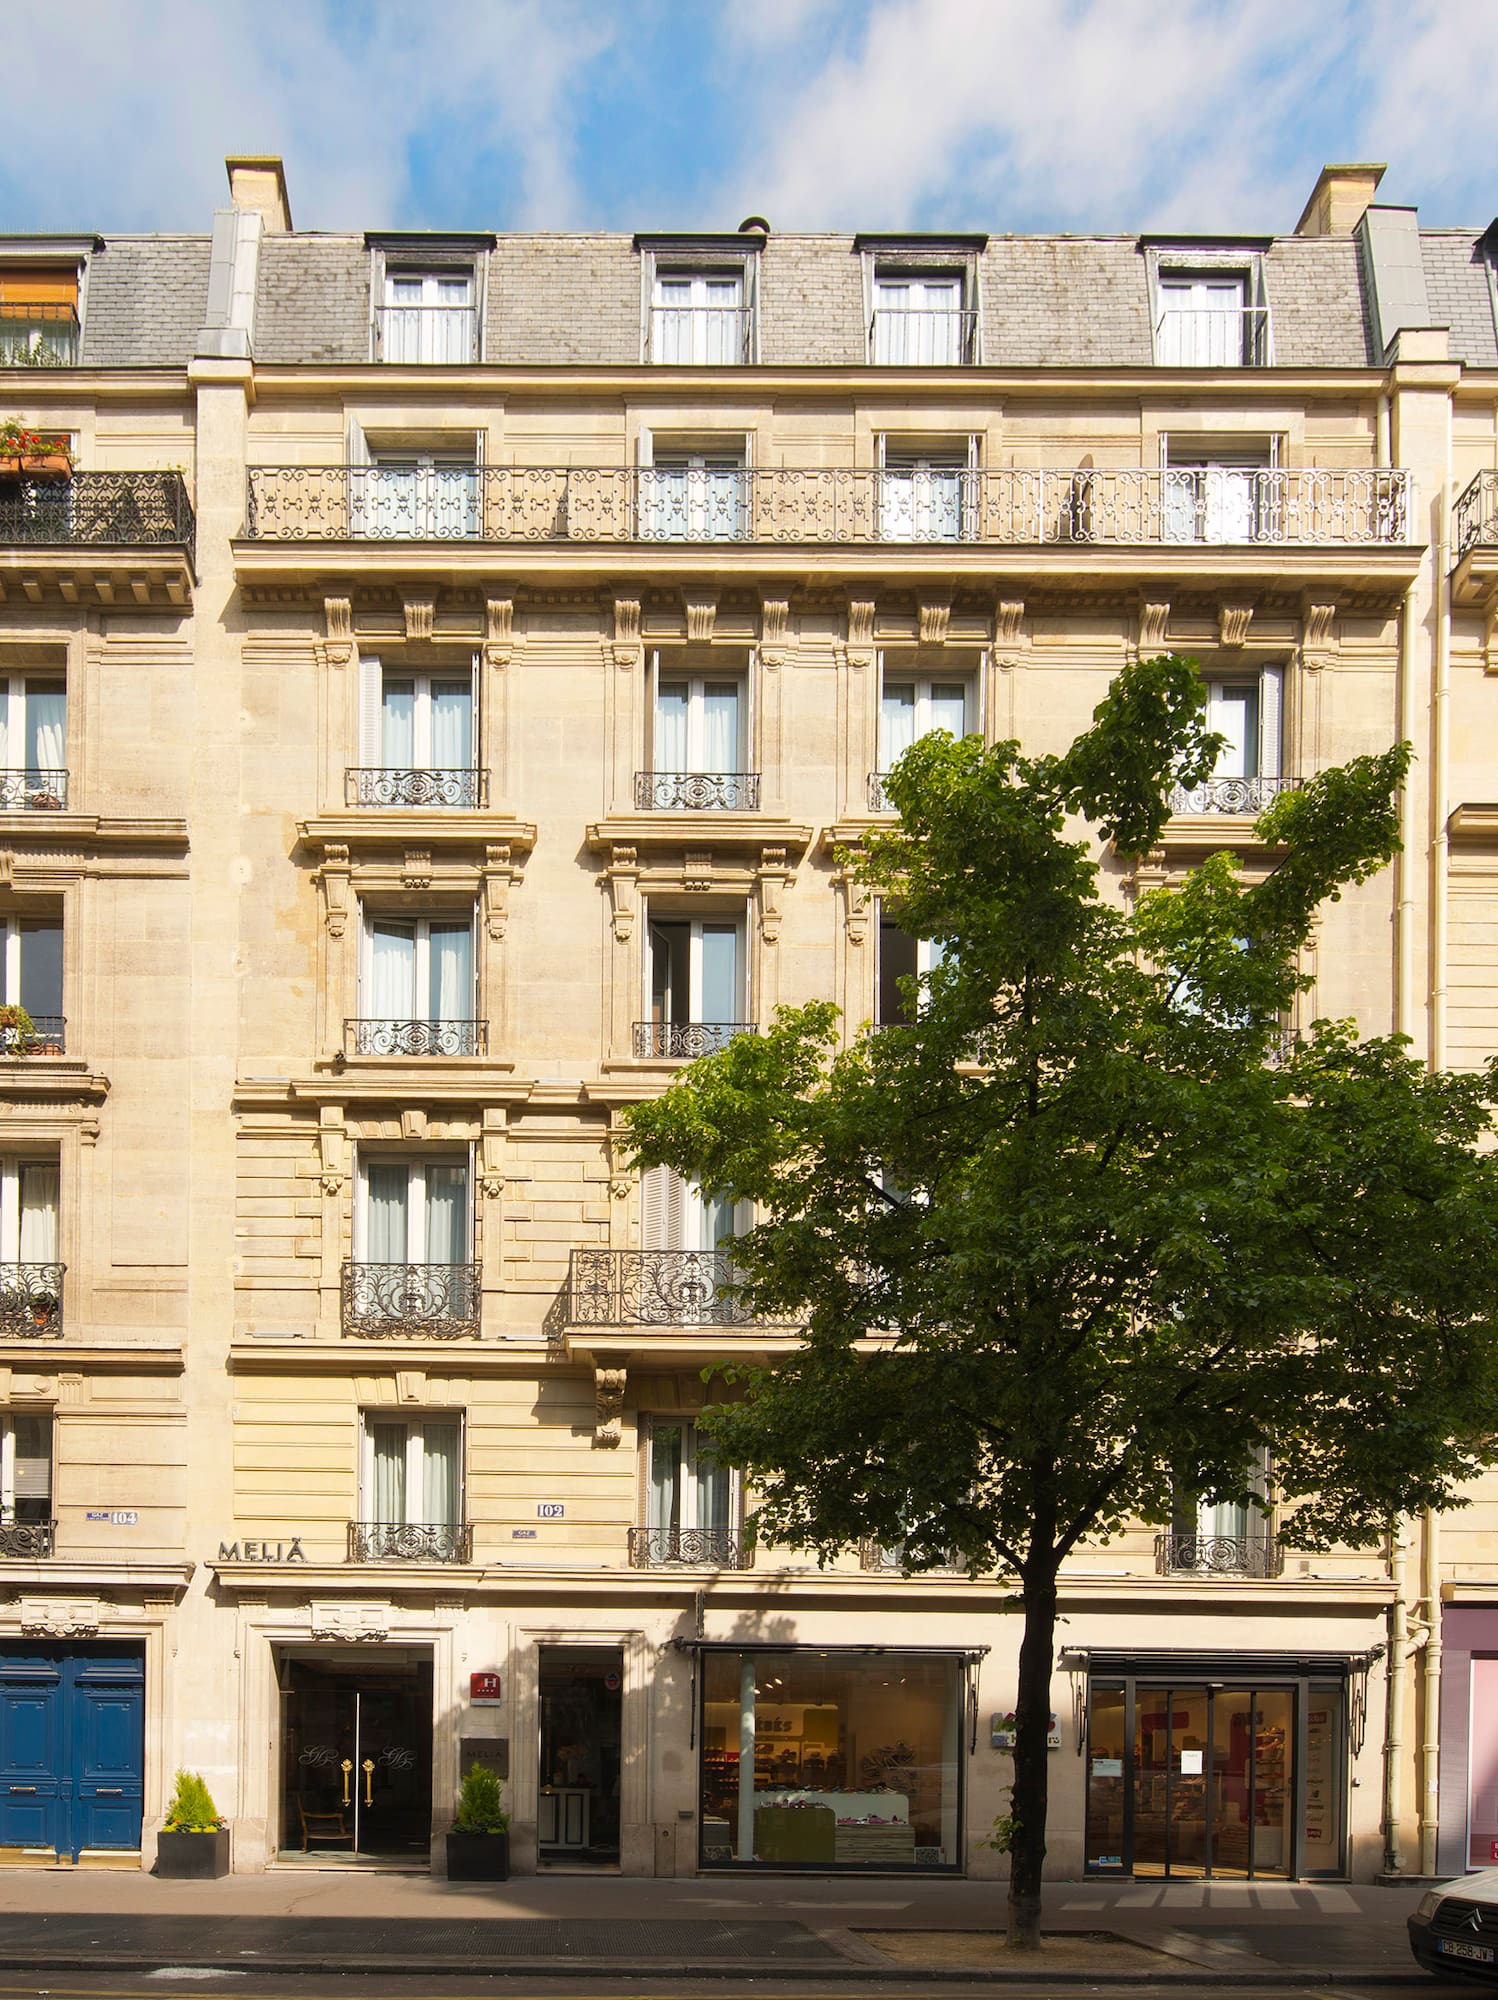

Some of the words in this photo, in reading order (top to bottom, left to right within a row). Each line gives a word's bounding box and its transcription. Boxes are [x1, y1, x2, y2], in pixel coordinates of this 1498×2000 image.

[539, 1504, 563, 1517] 102
[112, 1512, 137, 1524] 104
[484, 1678, 497, 1688] H
